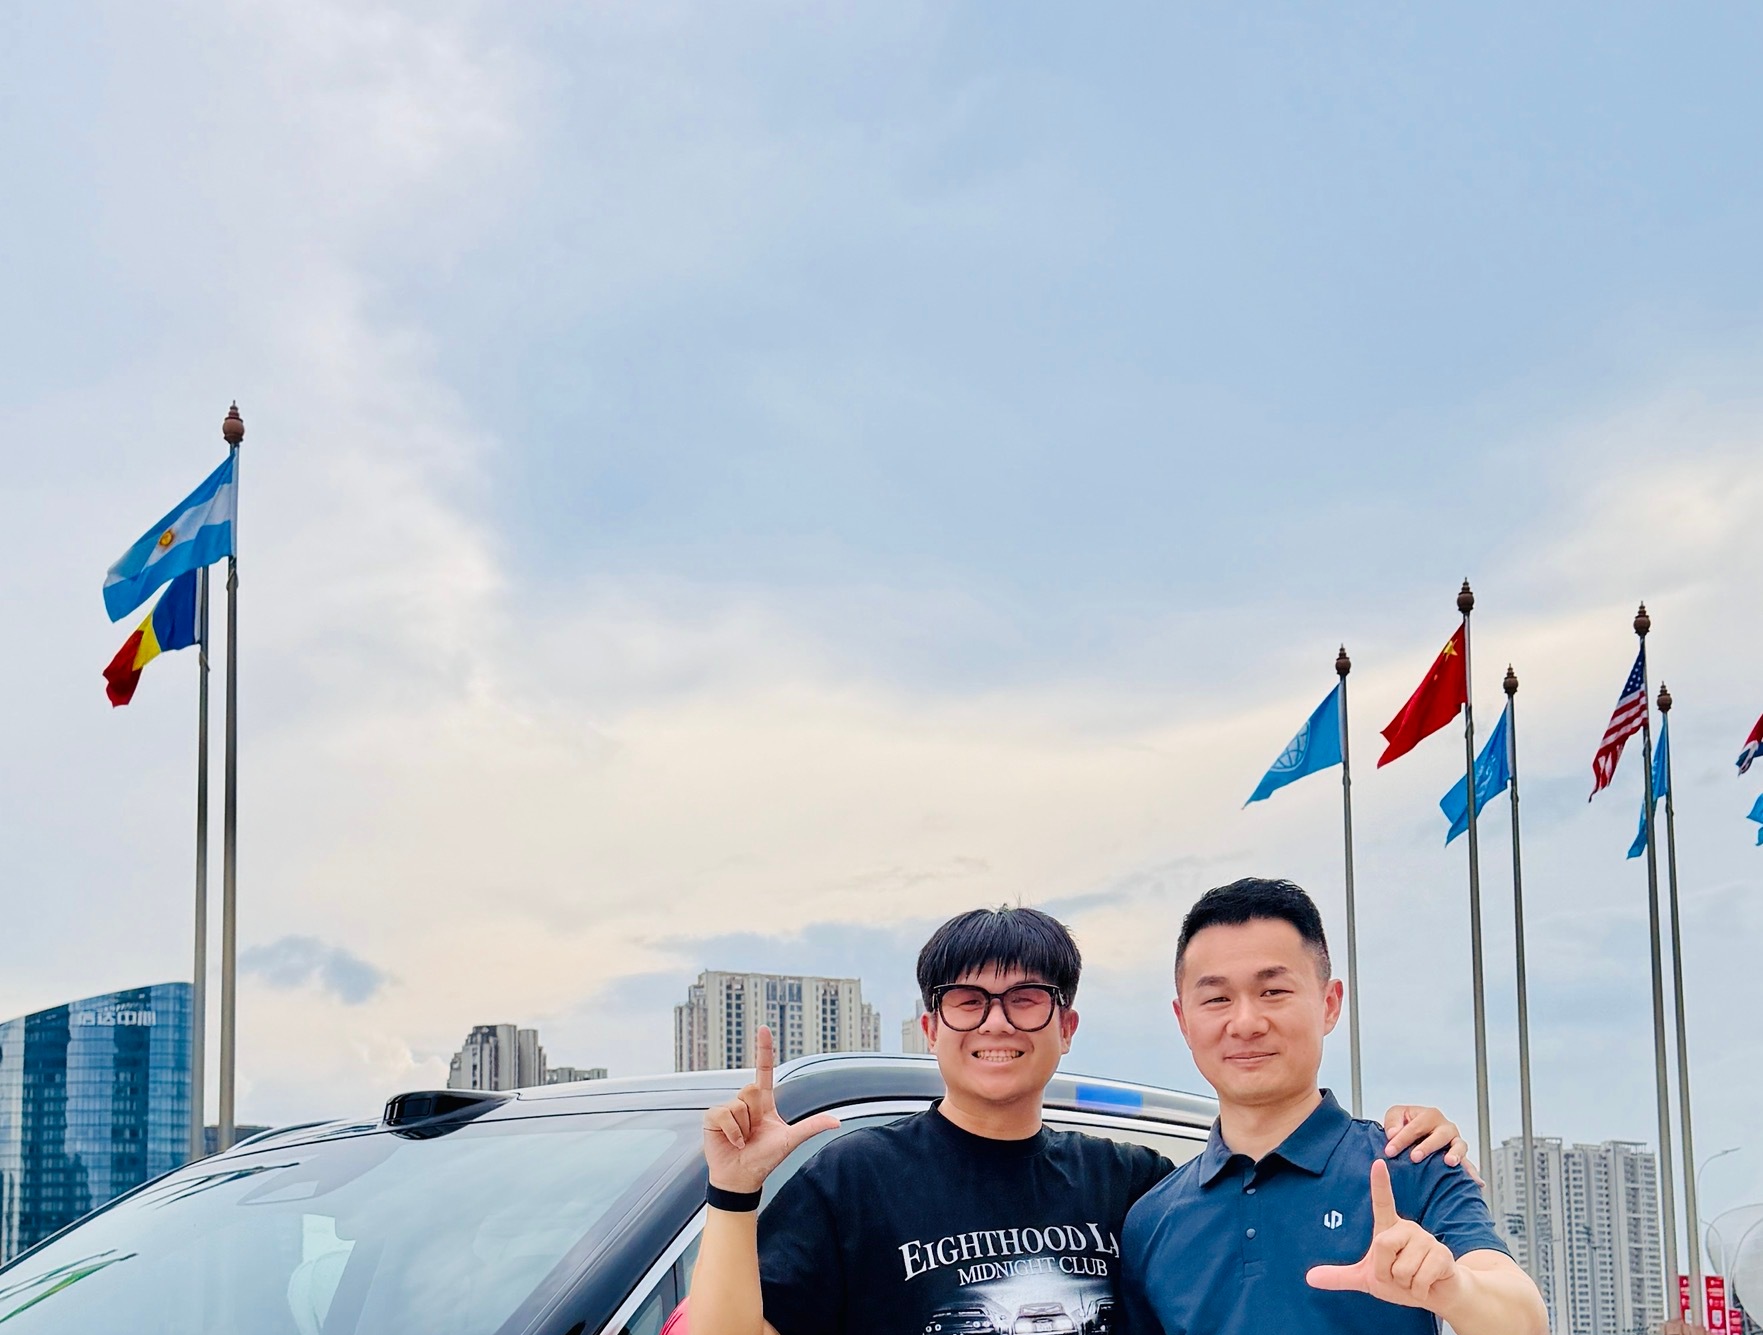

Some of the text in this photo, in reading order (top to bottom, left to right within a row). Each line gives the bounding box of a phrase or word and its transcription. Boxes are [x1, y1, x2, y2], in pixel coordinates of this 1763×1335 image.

[898, 1226, 1087, 1281] EIGHTHOOD
[957, 1256, 1108, 1286] MIDNIGHT CLUB
